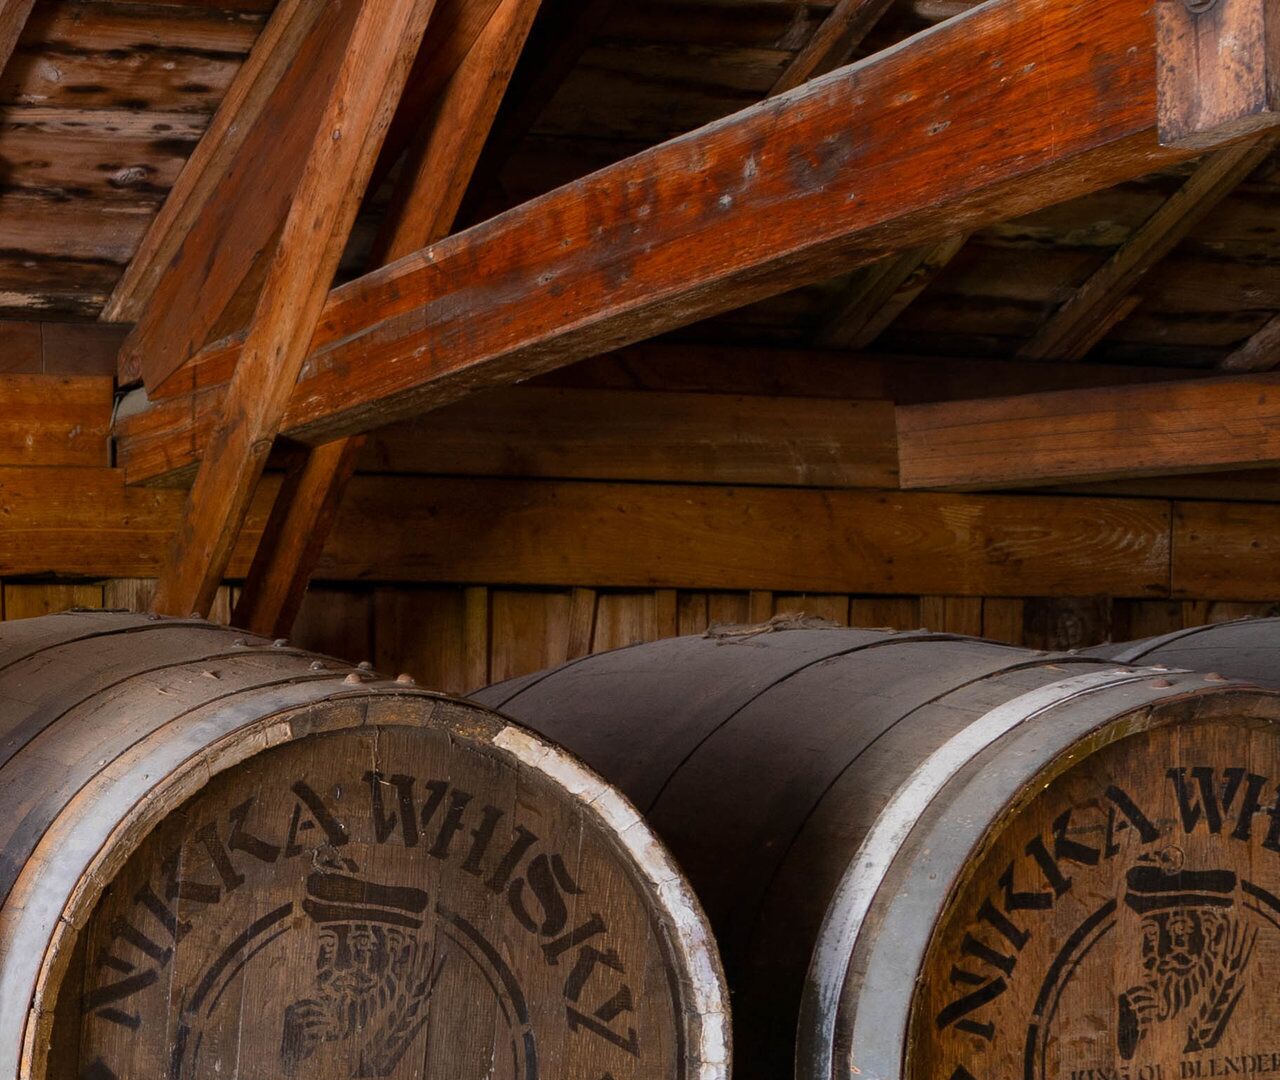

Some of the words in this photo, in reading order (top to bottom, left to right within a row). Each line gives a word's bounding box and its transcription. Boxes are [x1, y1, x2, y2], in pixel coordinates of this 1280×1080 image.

[81, 779, 351, 1030] NIKKA
[362, 769, 640, 1060] WHISKY
[935, 785, 1160, 1041] NIKKA
